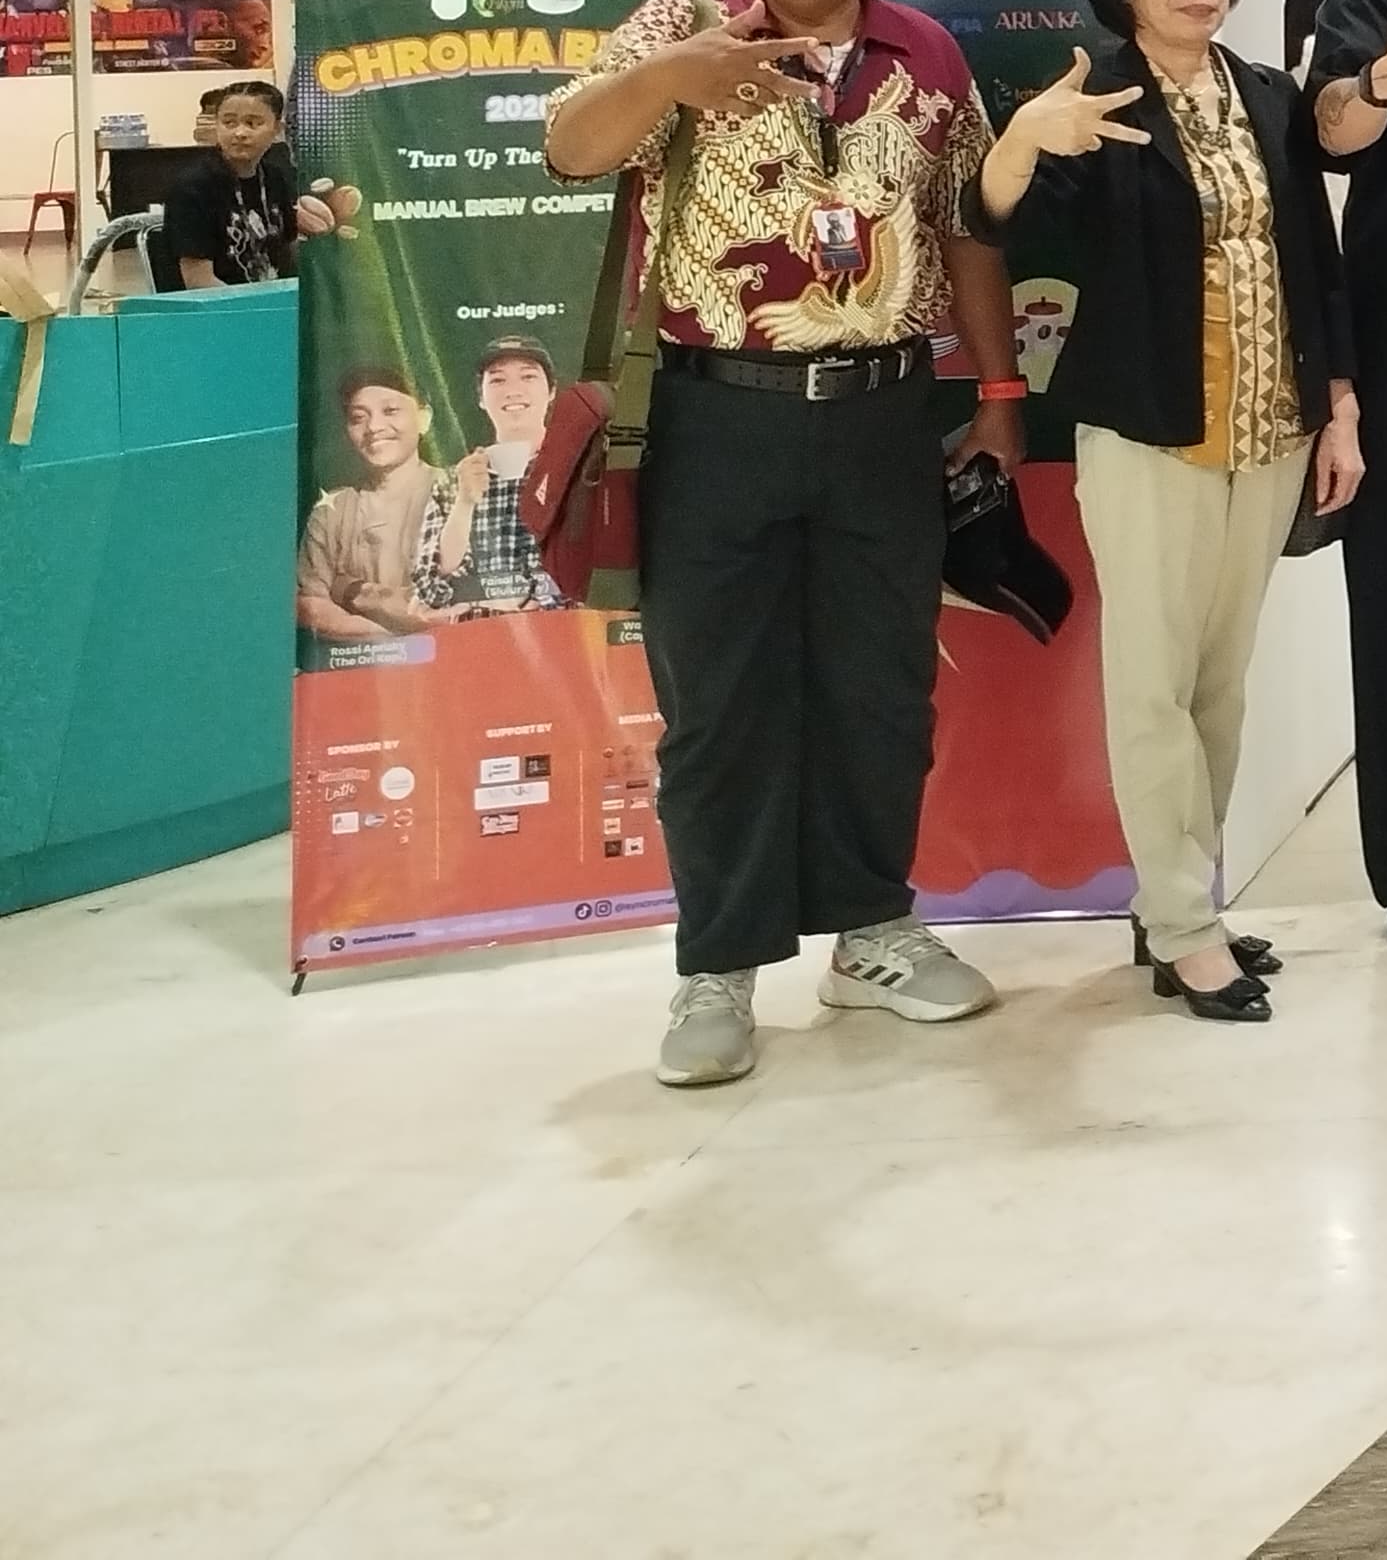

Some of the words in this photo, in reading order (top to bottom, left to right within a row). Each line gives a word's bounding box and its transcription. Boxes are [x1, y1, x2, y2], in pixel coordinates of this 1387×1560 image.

[316, 27, 557, 98] CHROMA
[465, 148, 498, 170] Up
[505, 147, 542, 167] The
[373, 199, 463, 221] MANUAL
[465, 197, 526, 217] BREW
[457, 303, 491, 321] Our
[485, 725, 535, 738] SUPPORT
[328, 742, 381, 755] SPONSOR
